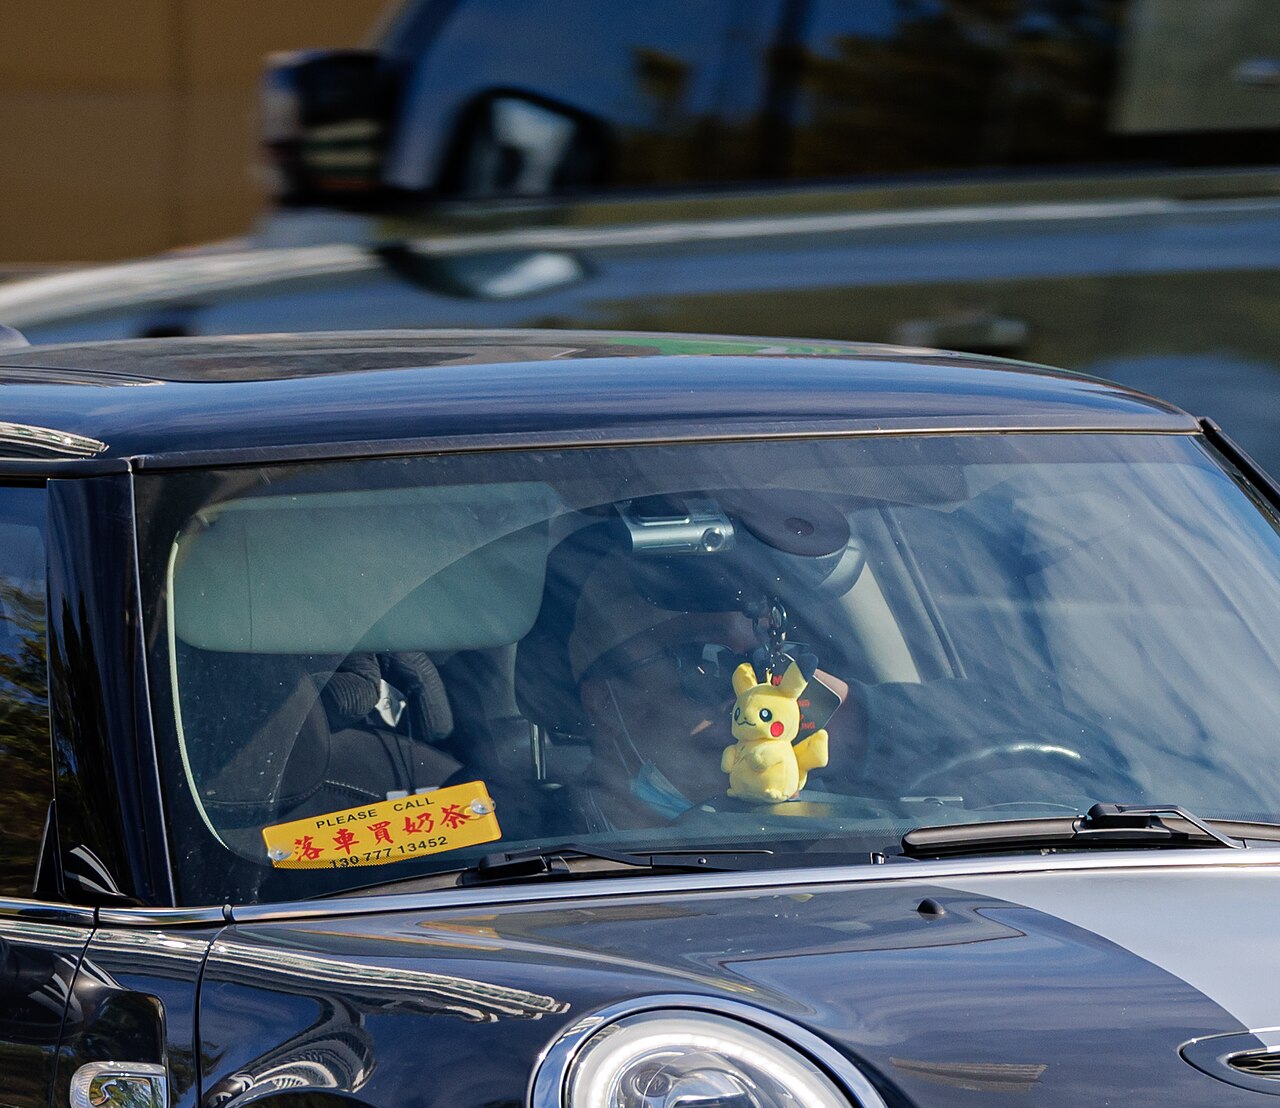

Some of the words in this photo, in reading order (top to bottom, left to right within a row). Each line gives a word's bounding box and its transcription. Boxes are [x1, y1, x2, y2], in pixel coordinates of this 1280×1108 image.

[316, 808, 378, 829] PLEASE
[393, 797, 435, 812] CALL
[293, 804, 471, 862] 落車買奶茶
[329, 855, 360, 869] 130
[363, 848, 392, 862] 777
[397, 836, 448, 854] 13452
